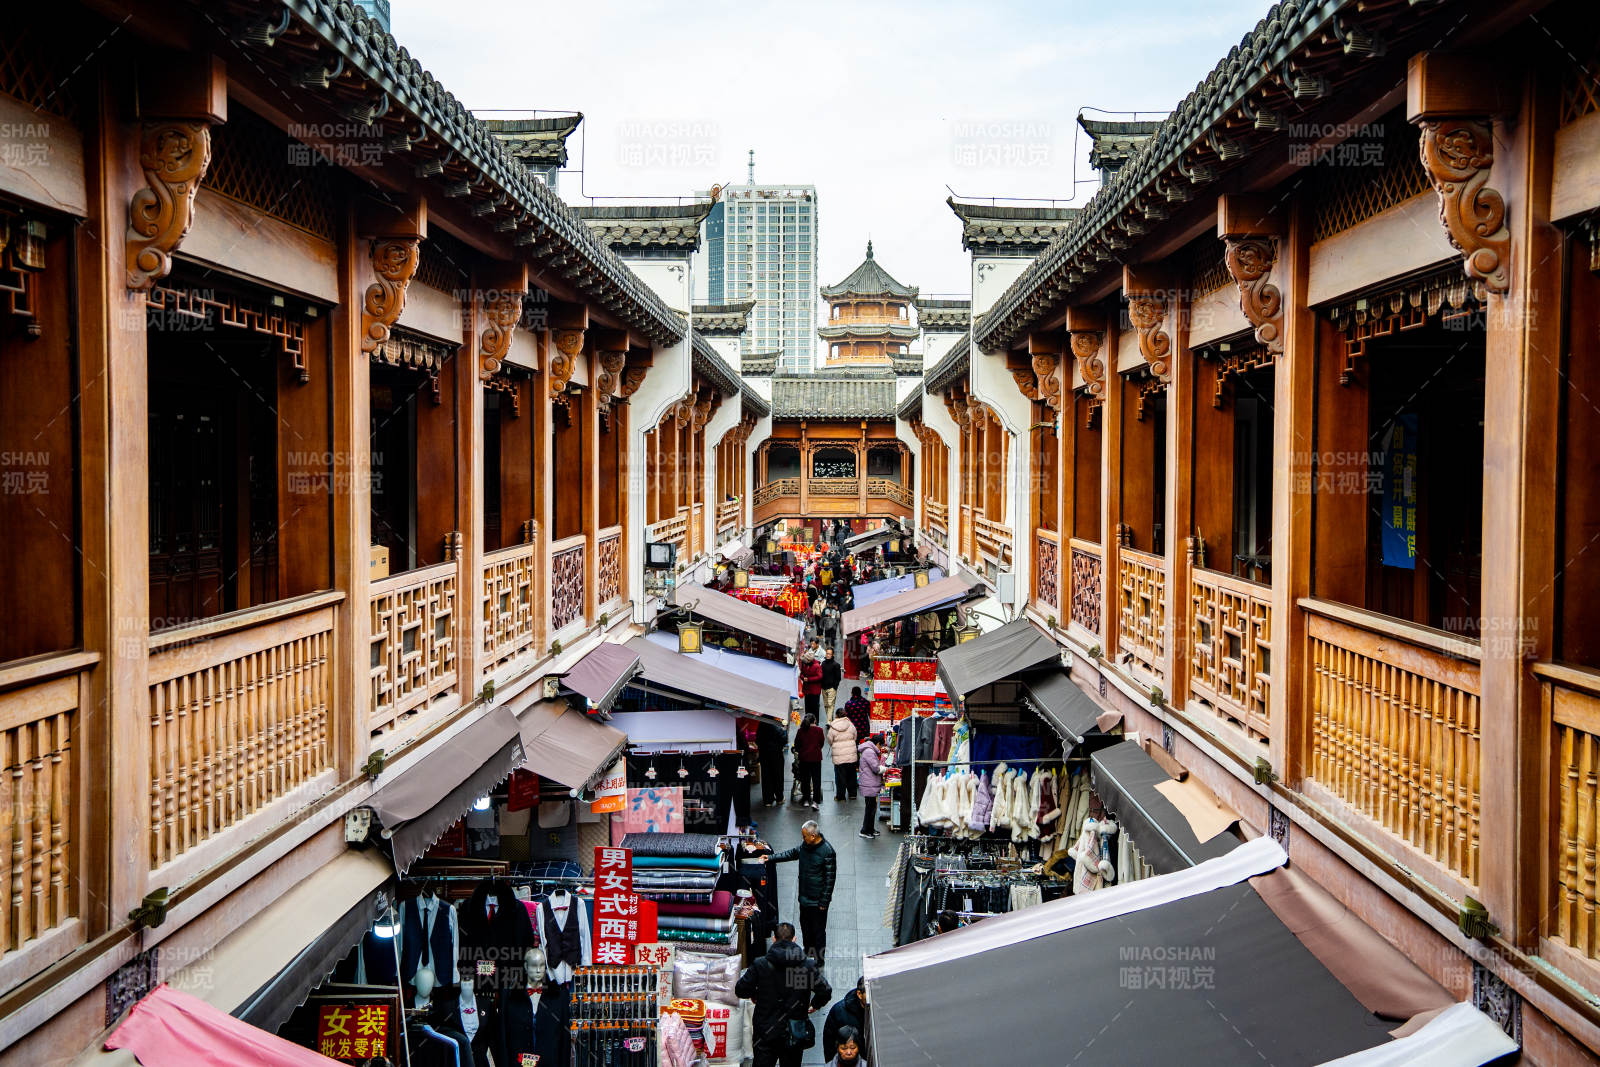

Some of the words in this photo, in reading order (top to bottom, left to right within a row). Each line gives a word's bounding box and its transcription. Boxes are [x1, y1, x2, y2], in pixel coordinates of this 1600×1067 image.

[596, 849, 628, 964] 男女式西装
[629, 895, 638, 915] 衬衫
[628, 920, 637, 940] 领带
[639, 946, 670, 968] 皮带
[323, 1007, 386, 1036] 女装
[321, 1038, 384, 1057] 批发零售
